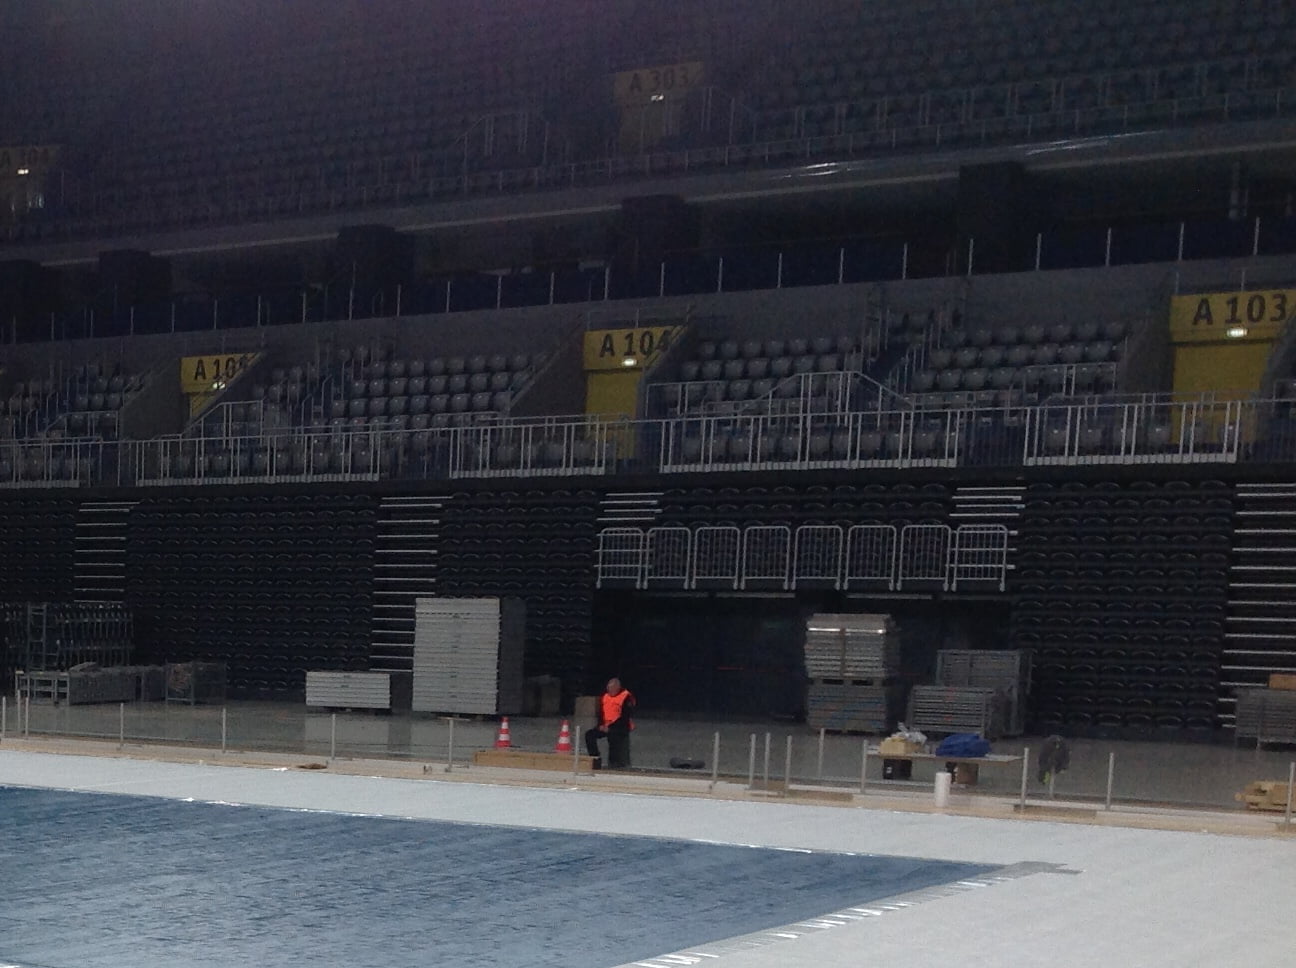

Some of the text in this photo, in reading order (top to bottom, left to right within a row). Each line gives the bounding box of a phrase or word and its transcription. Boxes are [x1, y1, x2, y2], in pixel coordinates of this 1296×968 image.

[629, 73, 642, 92] A
[1192, 293, 1287, 326] A 103
[599, 333, 616, 358] A
[194, 359, 206, 380] A
